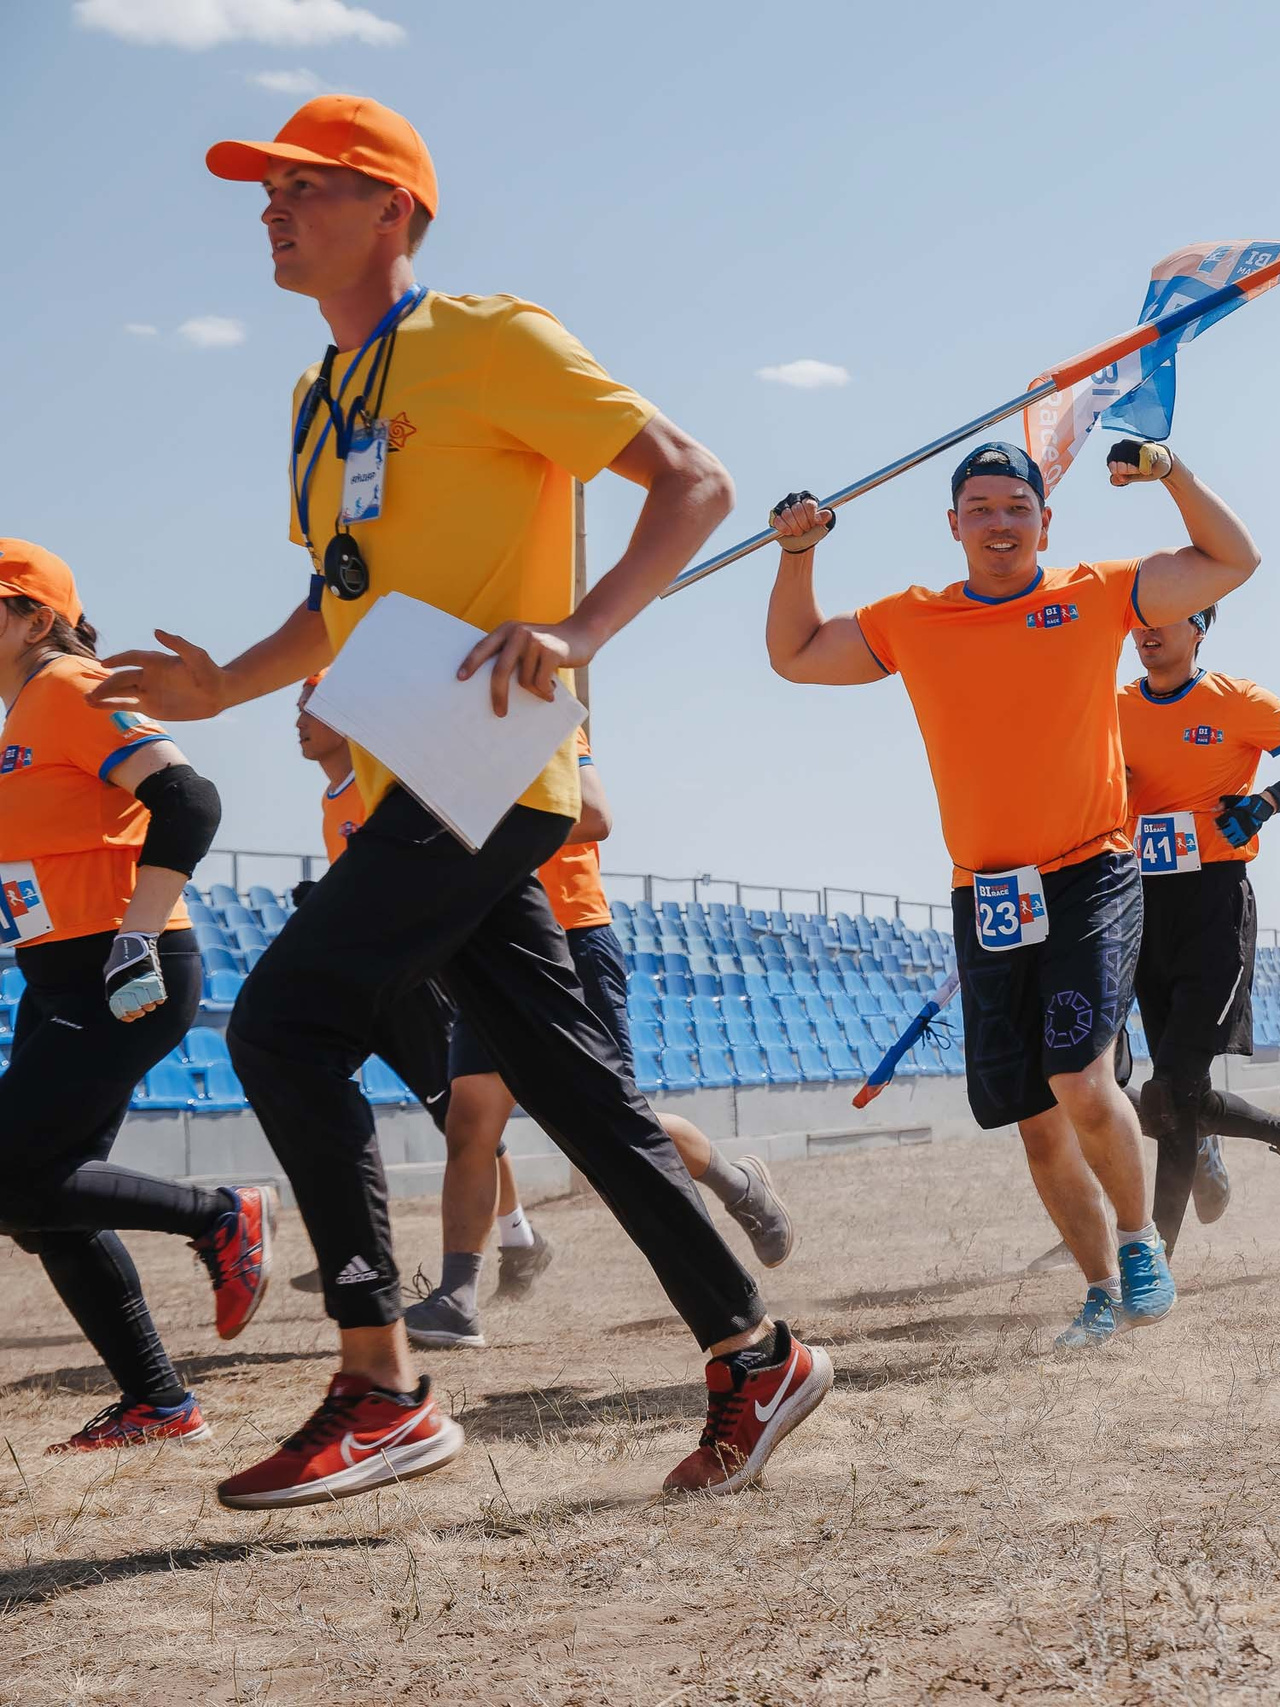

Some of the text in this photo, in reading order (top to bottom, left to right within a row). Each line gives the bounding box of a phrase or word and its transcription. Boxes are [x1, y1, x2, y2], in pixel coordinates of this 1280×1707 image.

[1143, 836, 1172, 864] 41
[979, 885, 992, 897] BI
[979, 901, 1020, 936] 23
[336, 1271, 379, 1284] adidas
